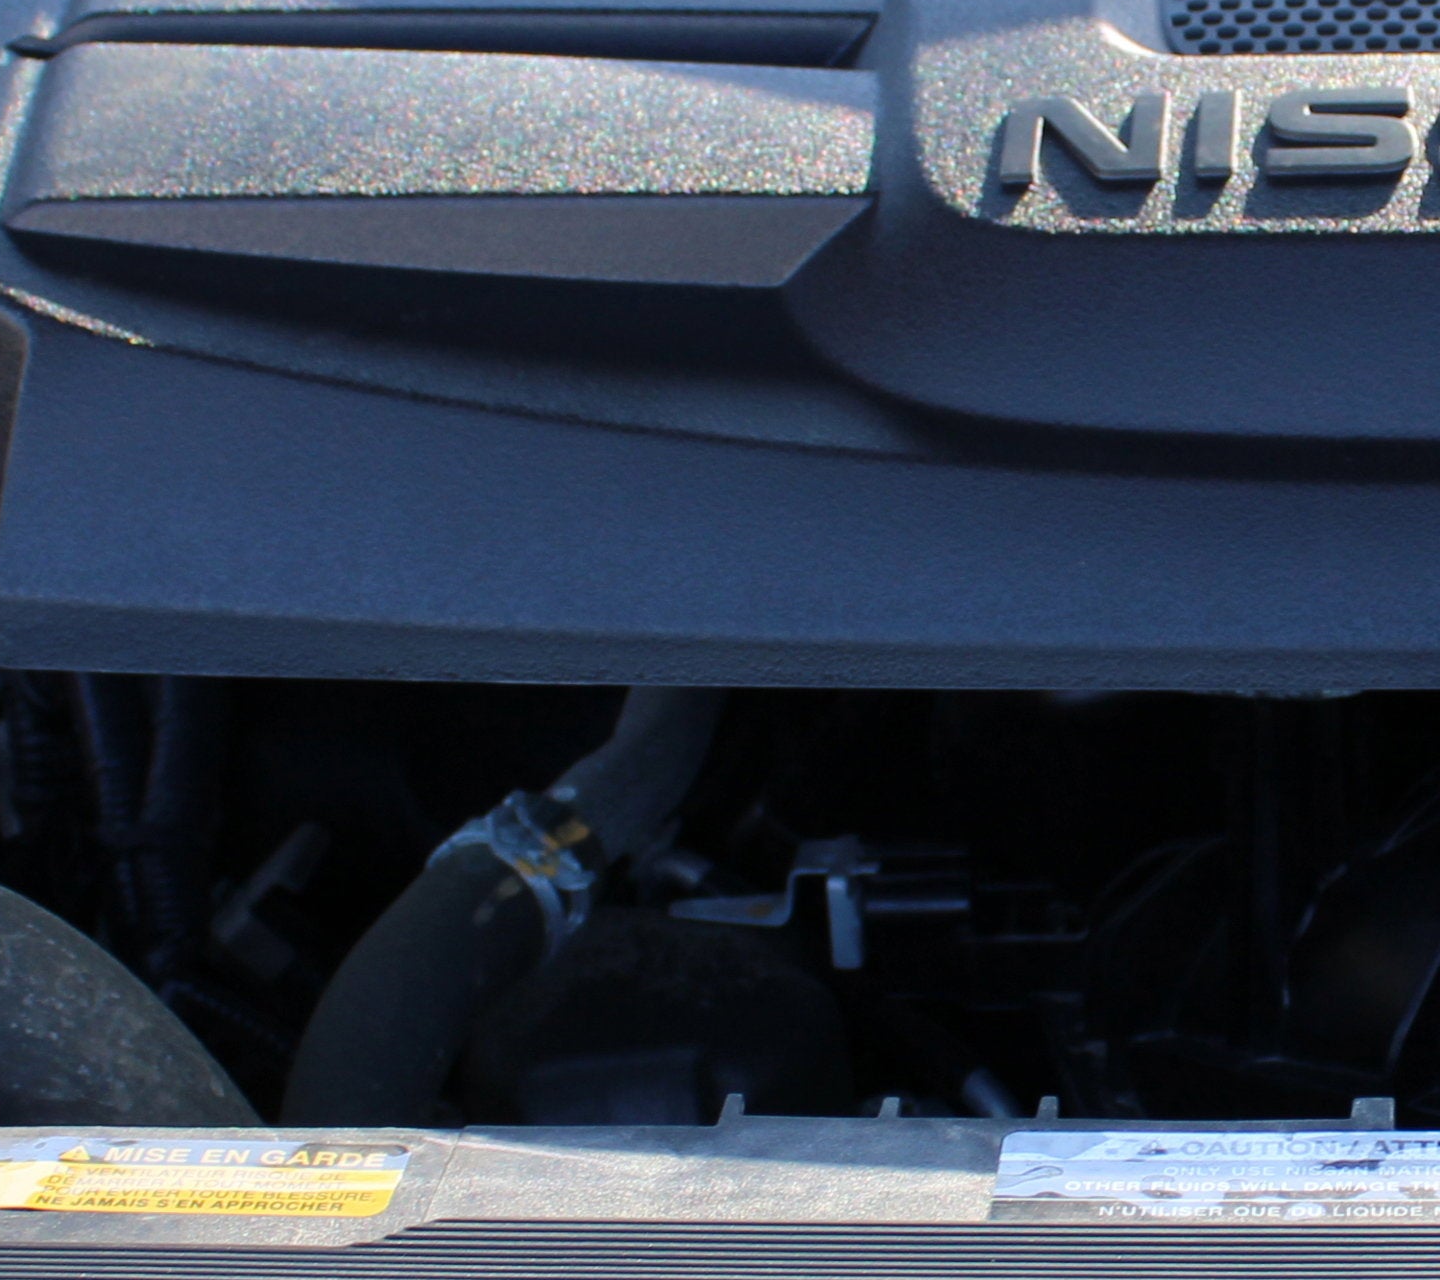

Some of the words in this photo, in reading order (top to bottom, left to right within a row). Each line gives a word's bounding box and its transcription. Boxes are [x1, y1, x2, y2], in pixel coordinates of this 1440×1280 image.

[1179, 1140, 1338, 1155] CAUTION
[103, 1147, 193, 1163] MISE
[200, 1149, 252, 1164] EN
[259, 1150, 389, 1168] GARDE
[86, 1167, 226, 1178] VENTILATEUR
[317, 1172, 347, 1181] DE
[1162, 1166, 1221, 1176] ONLY
[1230, 1166, 1276, 1176] USE
[1285, 1166, 1369, 1177] NISSAN
[1064, 1181, 1141, 1191] OTHER
[1150, 1181, 1231, 1191] FLUIDS
[1303, 1181, 1400, 1191] DAMAGE
[42, 1185, 100, 1196] POUR
[189, 1189, 257, 1199] TOUTE
[261, 1191, 377, 1202] BLESSURE,
[34, 1195, 66, 1205] NE
[69, 1197, 151, 1208] JAMAIS
[155, 1198, 206, 1209] S'EN
[210, 1200, 345, 1211] APPROCHER
[1098, 1206, 1222, 1217] N'UTILISER
[1233, 1206, 1282, 1218] QUE
[1291, 1206, 1322, 1217] DU
[1332, 1206, 1424, 1218] LIQUIDE
